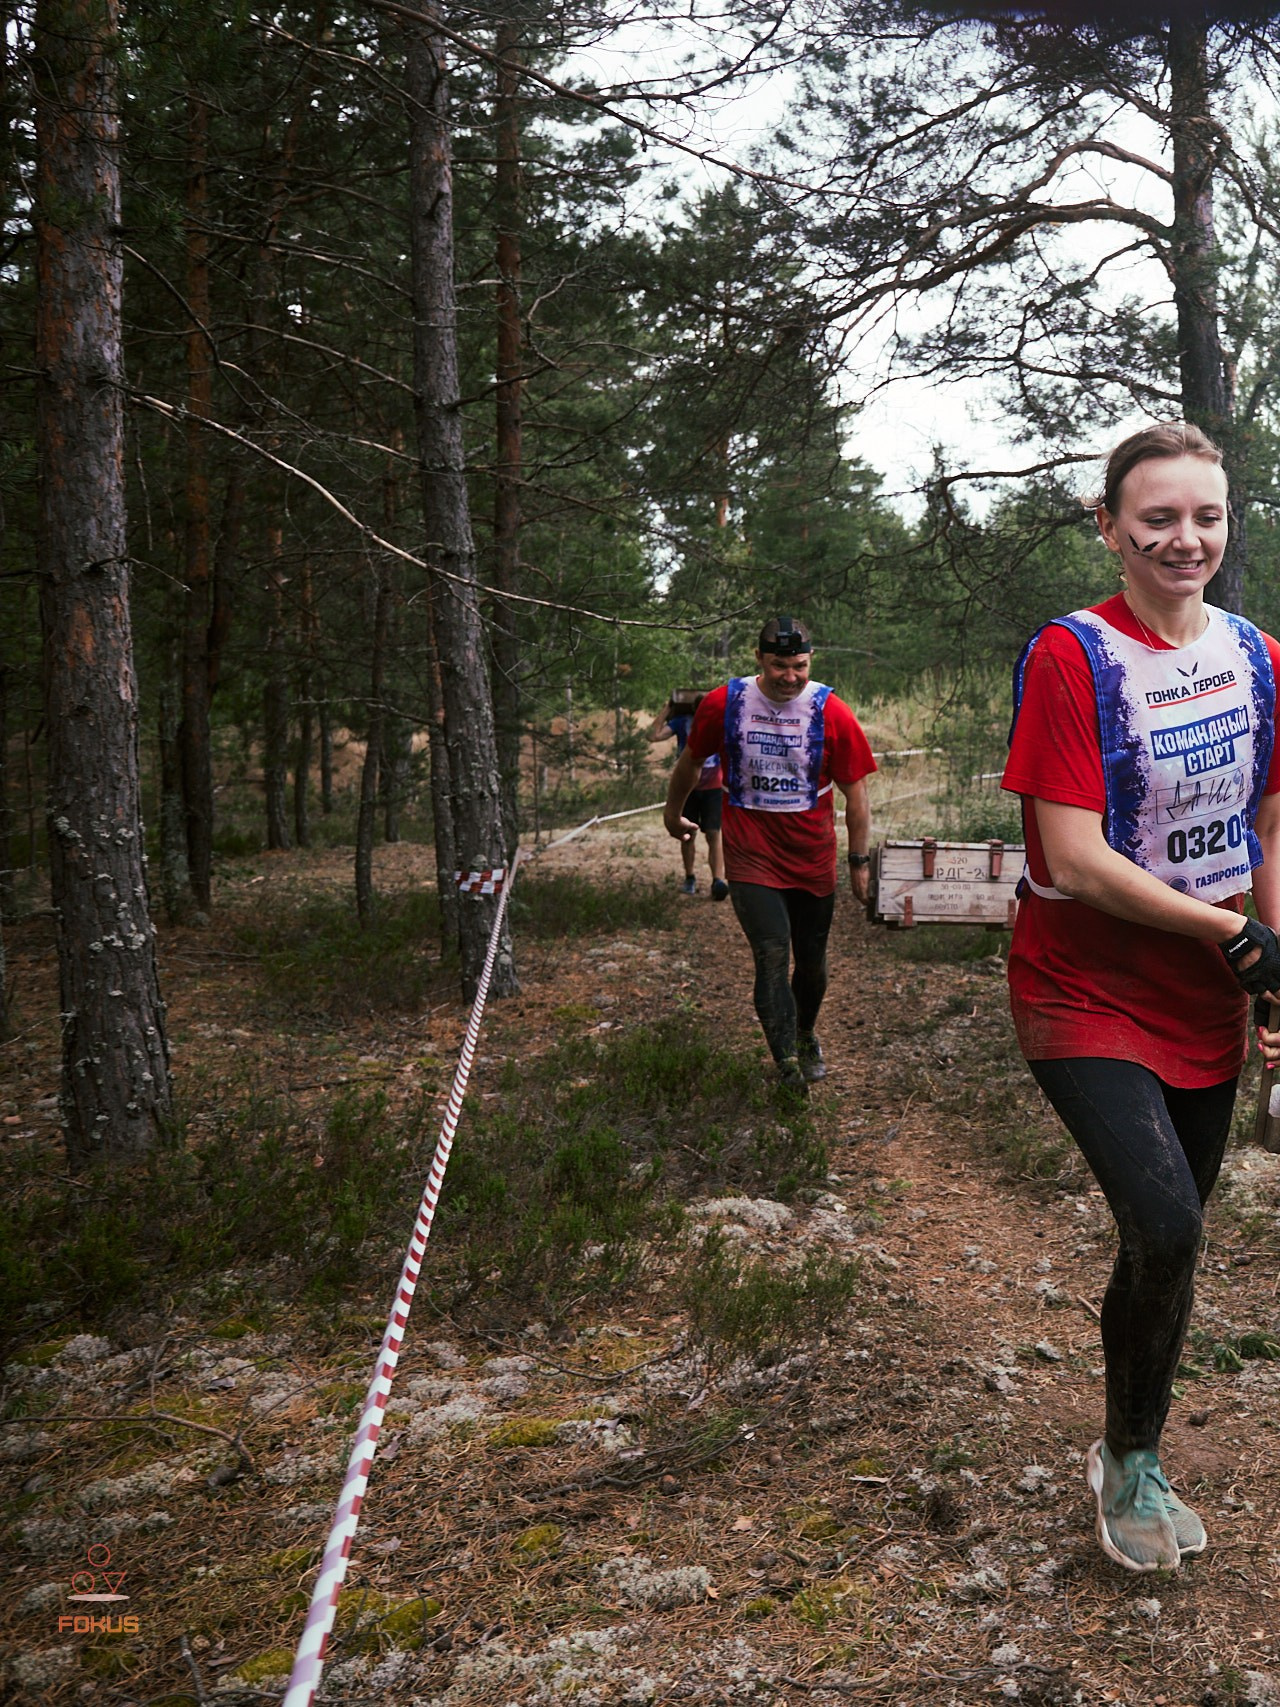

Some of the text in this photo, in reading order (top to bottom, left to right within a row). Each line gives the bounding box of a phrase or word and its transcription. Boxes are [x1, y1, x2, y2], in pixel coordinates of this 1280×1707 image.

[1145, 670, 1236, 704] ГОНКА ГЕРОЕВ
[751, 714, 776, 722] ГОНКА
[1153, 705, 1249, 755] КОМАНДНЫЙ
[748, 732, 801, 747] КОМАНДНЫЙ
[762, 745, 787, 756] СТАРТ
[1186, 741, 1231, 774] СТАРТ
[751, 775, 799, 792] 03206
